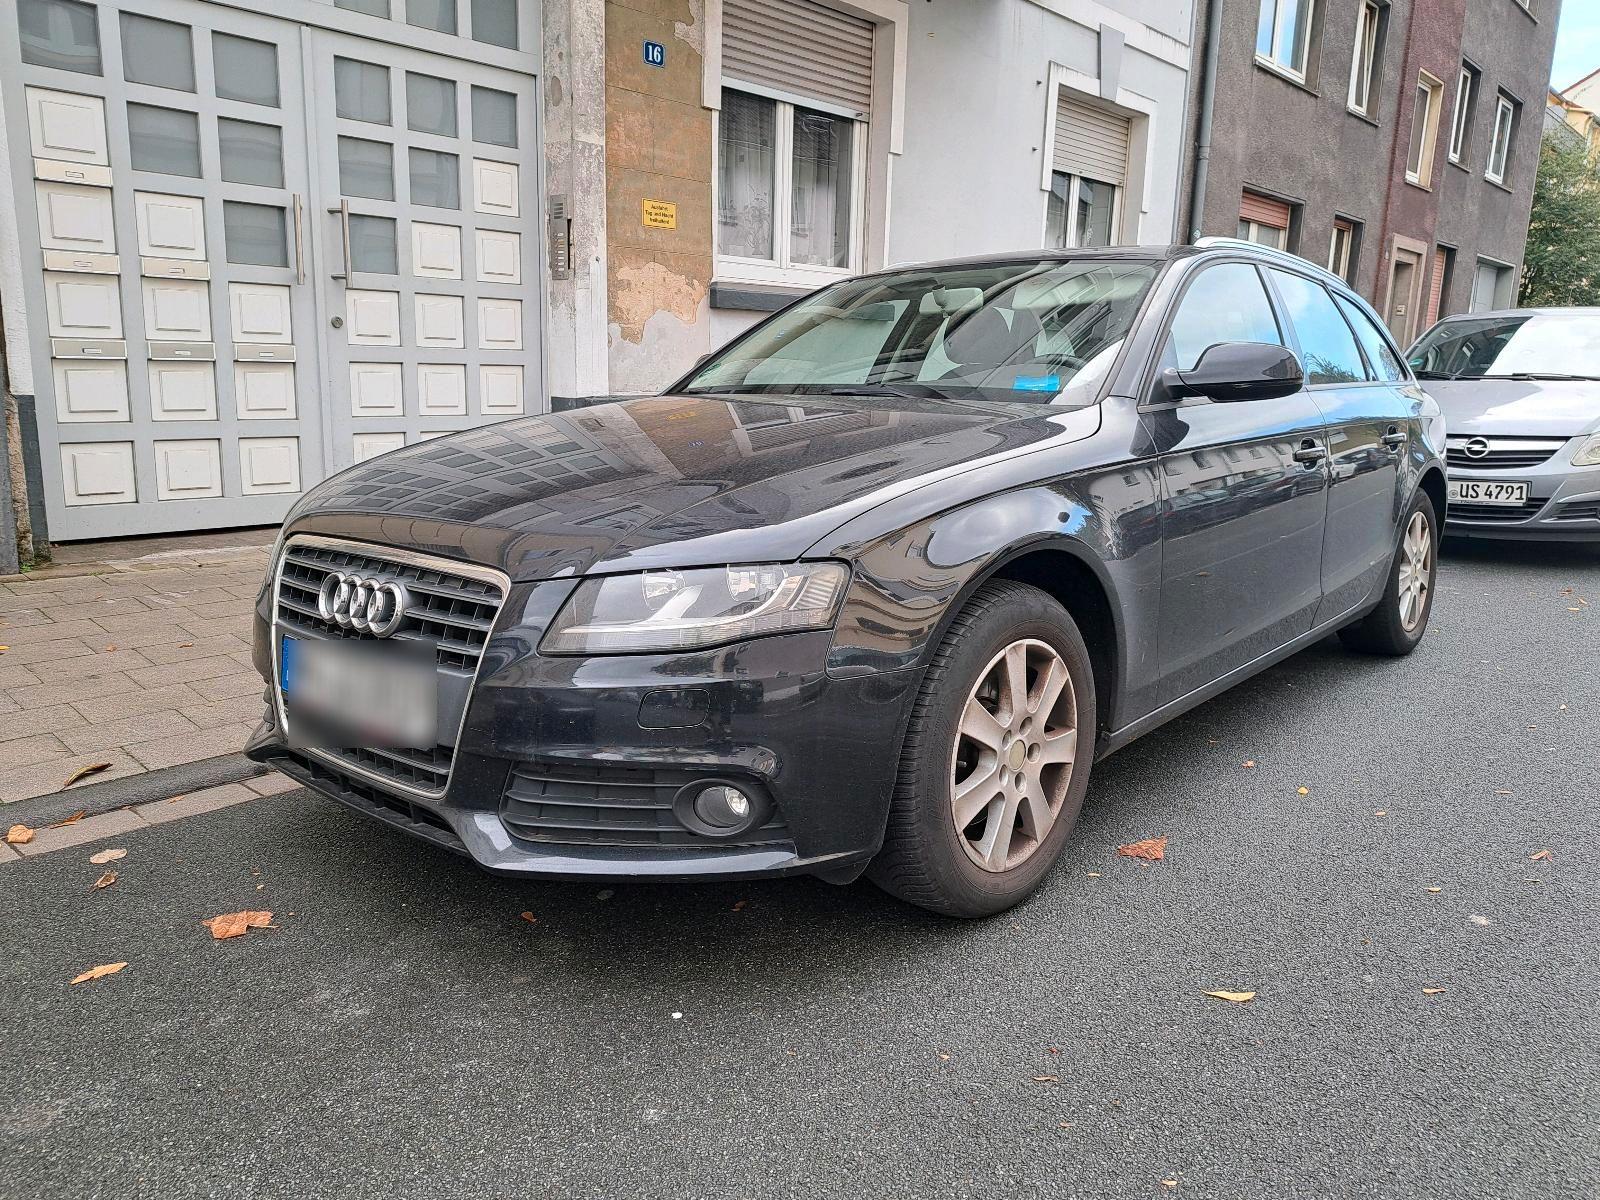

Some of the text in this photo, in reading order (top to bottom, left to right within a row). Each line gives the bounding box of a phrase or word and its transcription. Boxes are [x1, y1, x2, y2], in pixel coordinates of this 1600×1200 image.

[648, 45, 662, 63] 16
[1460, 483, 1525, 501] US 4791
